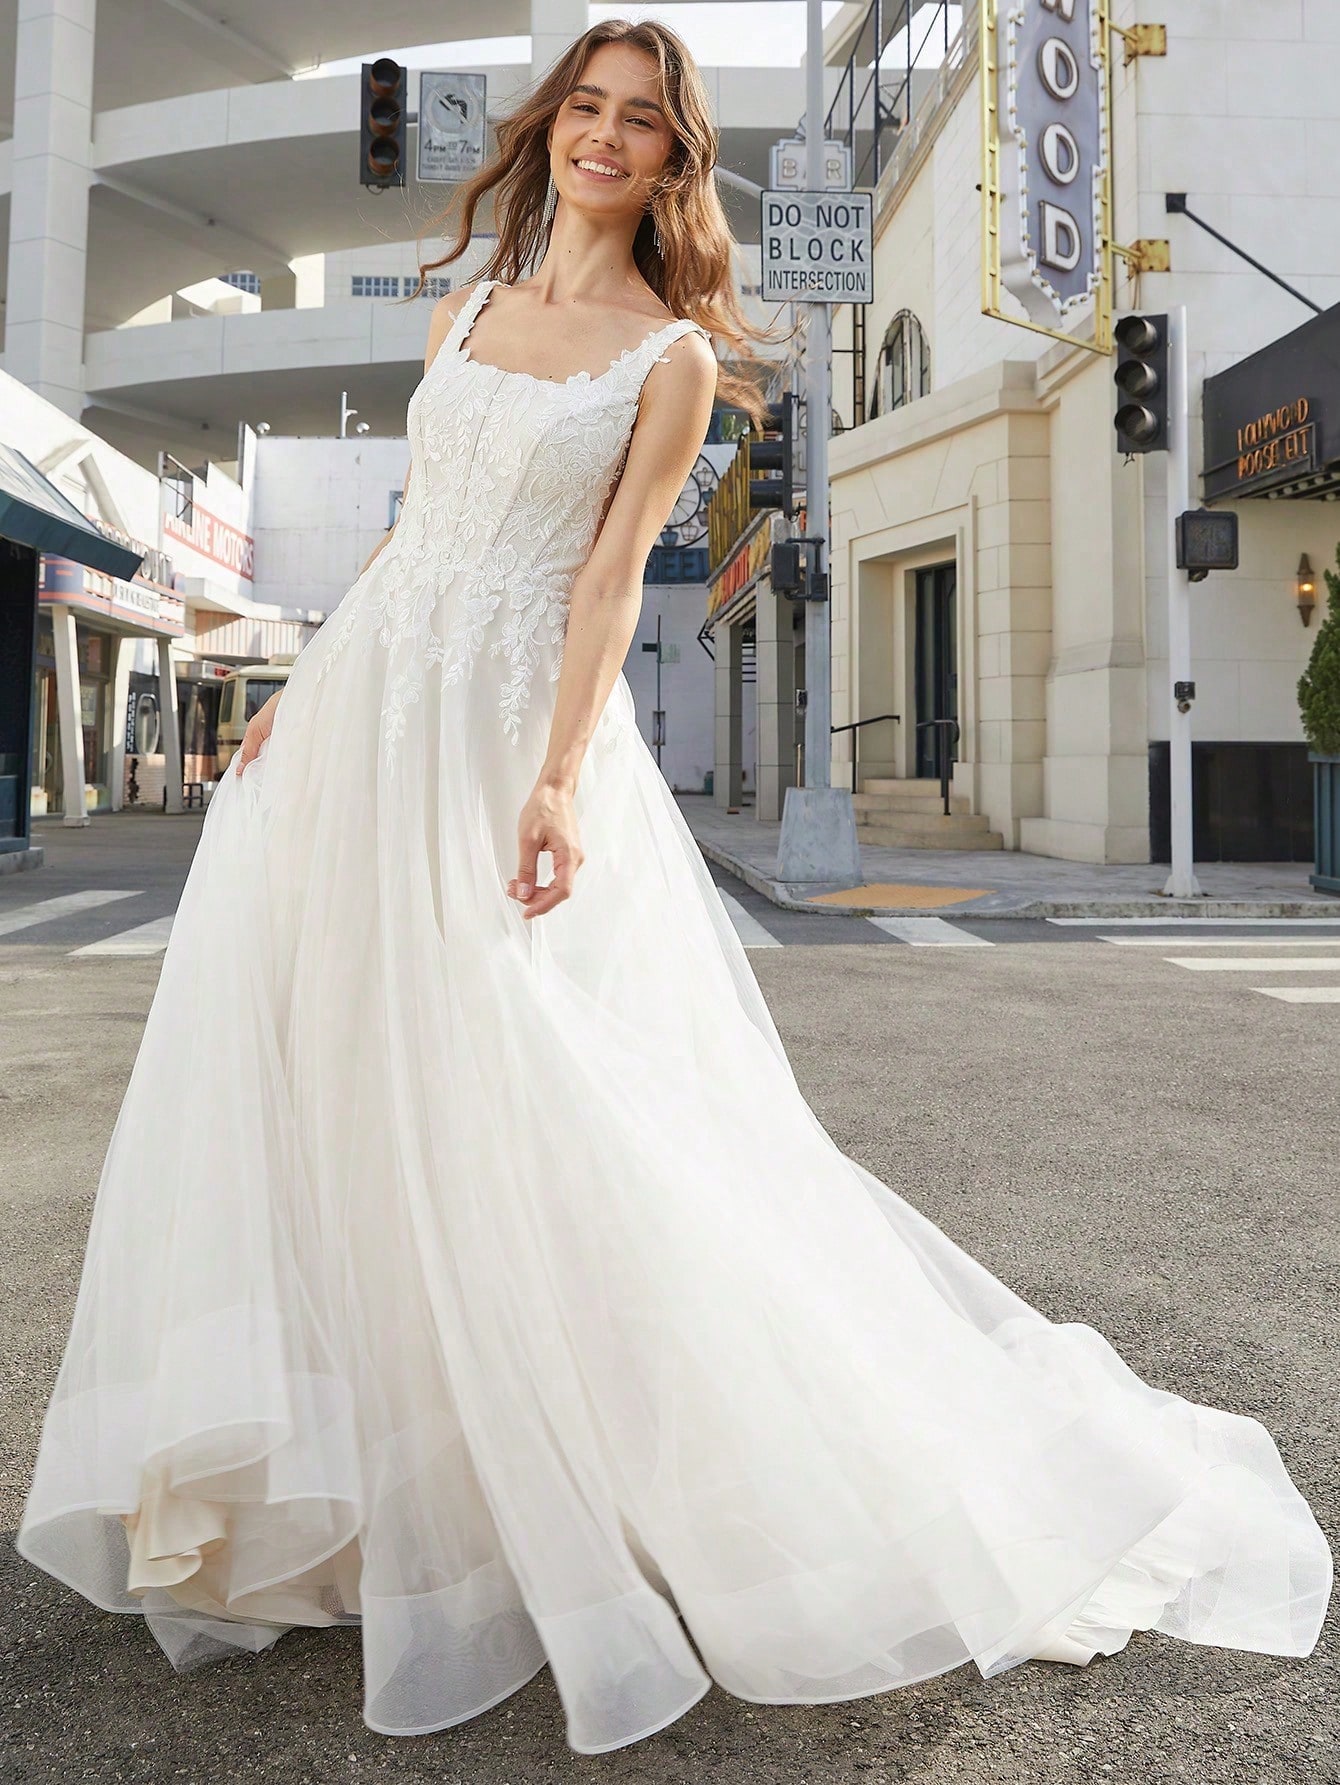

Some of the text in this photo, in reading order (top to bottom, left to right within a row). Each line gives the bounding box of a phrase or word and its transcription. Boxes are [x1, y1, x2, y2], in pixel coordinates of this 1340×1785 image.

[1036, 0, 1081, 271] OOD
[783, 159, 842, 180] BR
[769, 204, 865, 229] DO NOT
[769, 237, 865, 262] BLOCK
[769, 270, 866, 291] INTERSECTION
[1237, 429, 1309, 480] ROOSEELT
